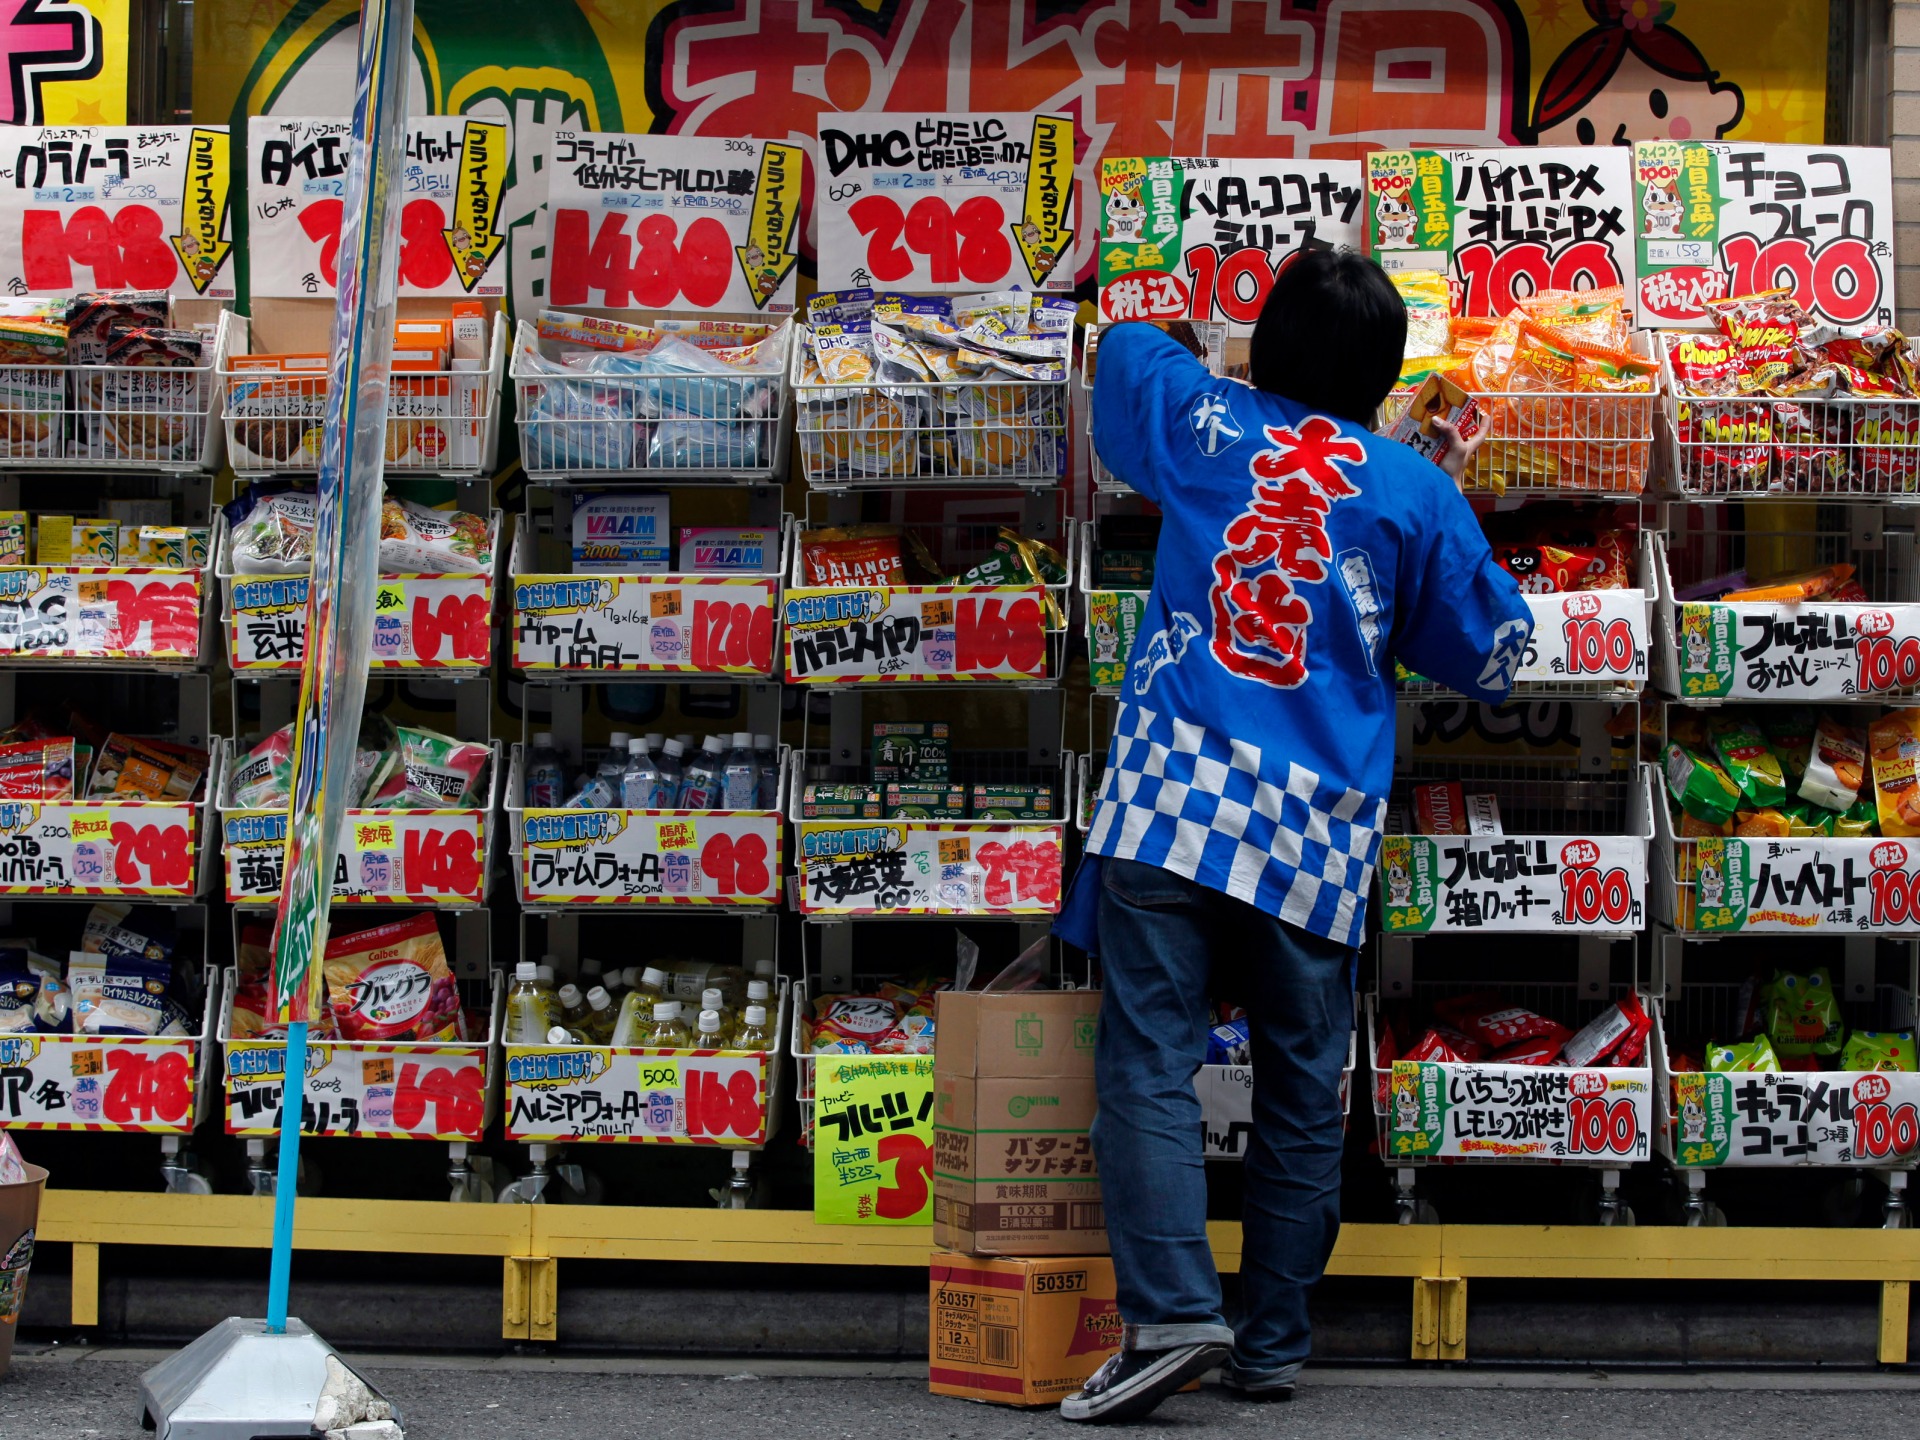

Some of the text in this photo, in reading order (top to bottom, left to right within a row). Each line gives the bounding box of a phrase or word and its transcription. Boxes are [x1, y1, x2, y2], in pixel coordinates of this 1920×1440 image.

[280, 122, 303, 133] meiji
[555, 131, 575, 140] ITO
[915, 118, 1008, 148] ビタミンC
[556, 139, 646, 165] コラーゲン
[724, 139, 755, 157] 300g
[820, 128, 915, 177] DHC
[16, 138, 130, 189] グラノーラ
[133, 153, 172, 168] シリーズ
[959, 166, 988, 179] 定価
[468, 128, 488, 248] プライスダウン
[1038, 123, 1058, 243] プライスダウン
[1123, 175, 1147, 192] SHOP
[1726, 152, 1851, 201] チョコ
[122, 185, 158, 199] 238
[195, 136, 217, 254] プライスダウン
[710, 197, 743, 209] 5040
[766, 150, 787, 266] プライスダウン
[1749, 200, 1874, 240] フレーク
[22, 205, 178, 290] 198
[847, 195, 1012, 284] 298
[1676, 243, 1701, 258] 158
[550, 208, 733, 308] 1480
[1104, 244, 1164, 271] 全品
[8, 277, 28, 296] 各
[301, 273, 320, 293] 各
[851, 268, 872, 288] 各
[1454, 238, 1624, 318] 100
[1719, 231, 1883, 325] 100
[1108, 275, 1185, 320] 税込
[818, 334, 850, 350] DHC
[1679, 340, 1725, 365] Choco
[586, 515, 656, 535] VAAM
[580, 545, 621, 560] 3000
[694, 547, 763, 565] VAAM
[816, 555, 903, 584] BALANCE
[523, 608, 547, 619] meiji
[1566, 596, 1599, 618] 税込
[411, 593, 492, 661] 698
[690, 599, 775, 668] 1280
[955, 597, 1047, 673] 168
[1859, 611, 1892, 635] 税込
[1550, 617, 1646, 676] 各 100 円
[1686, 673, 1720, 695] 全品
[1747, 655, 1819, 693] おかし
[1840, 678, 1857, 695] 各
[878, 738, 947, 767] 青汁 100%
[109, 821, 190, 887] 298
[362, 852, 389, 866] 定価
[565, 843, 590, 854] meiji
[664, 853, 691, 866] 定価
[1564, 843, 1598, 863] 税込
[1873, 843, 1905, 867] 税込
[403, 827, 481, 895] 148
[700, 832, 770, 896] 98
[1443, 838, 1558, 890] ブルボン
[1444, 884, 1552, 928] 箱クッキー
[1551, 866, 1643, 926] 各 100 円
[1388, 907, 1423, 929] 全品
[1700, 907, 1734, 930] 全品
[1856, 916, 1870, 931] 各
[368, 948, 400, 963] Calbee
[103, 1049, 190, 1124] 248
[530, 1082, 558, 1094] Kao
[1573, 1074, 1605, 1094] 税込
[1856, 1077, 1888, 1101] 税込
[393, 1063, 486, 1135] 698
[685, 1068, 762, 1137] 168
[1735, 1079, 1855, 1125] キャラメル
[1550, 1140, 1566, 1157] 各
[1567, 1096, 1639, 1155] 100
[1837, 1102, 1919, 1163] 各 100
[1395, 1132, 1430, 1154] 全品
[1741, 1123, 1818, 1158] コーン
[1682, 1142, 1717, 1165] 全品
[995, 1183, 1048, 1200] 賞味期限
[1036, 1273, 1084, 1292] 50357
[938, 1290, 977, 1309] 50357
[947, 1331, 972, 1346] 12入
